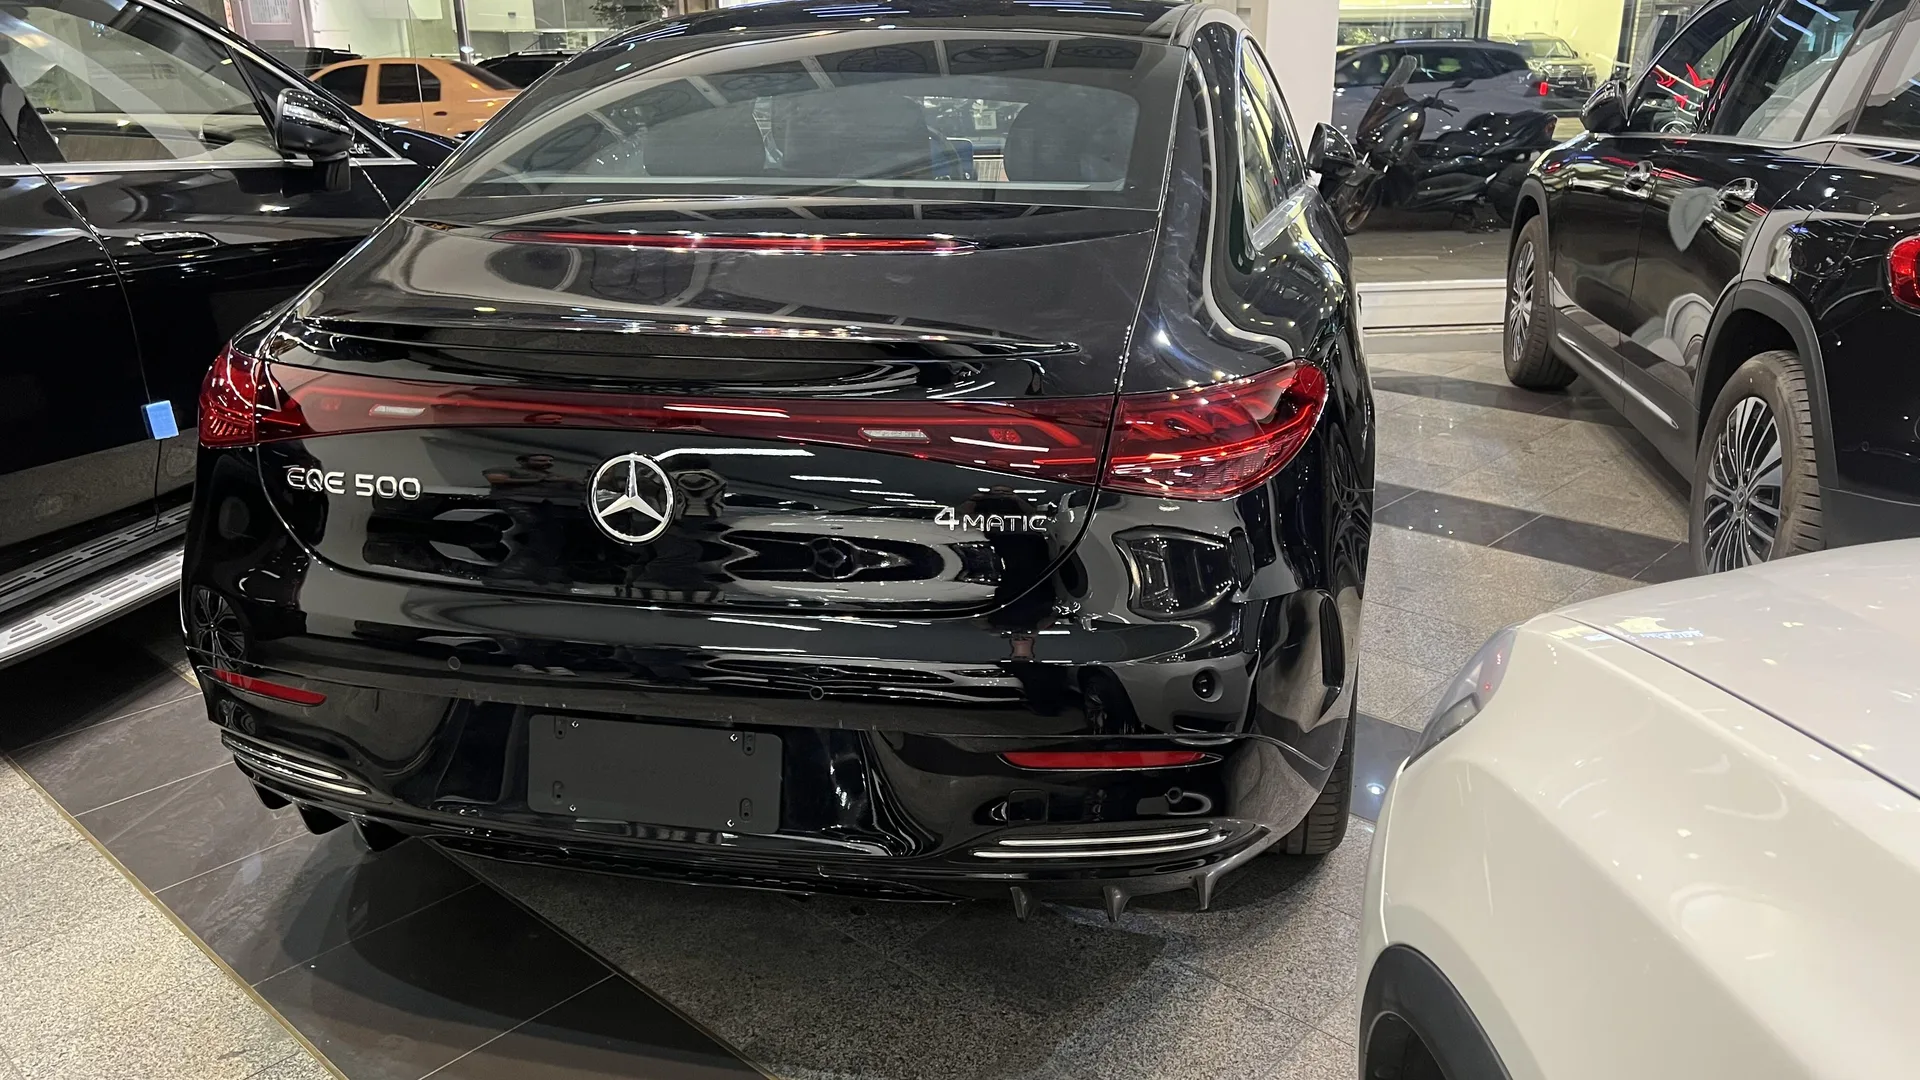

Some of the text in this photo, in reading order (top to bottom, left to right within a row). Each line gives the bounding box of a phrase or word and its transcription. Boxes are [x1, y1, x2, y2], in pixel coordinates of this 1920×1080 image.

[287, 467, 421, 500] EQE 500
[934, 506, 1047, 531] 4MATIC
